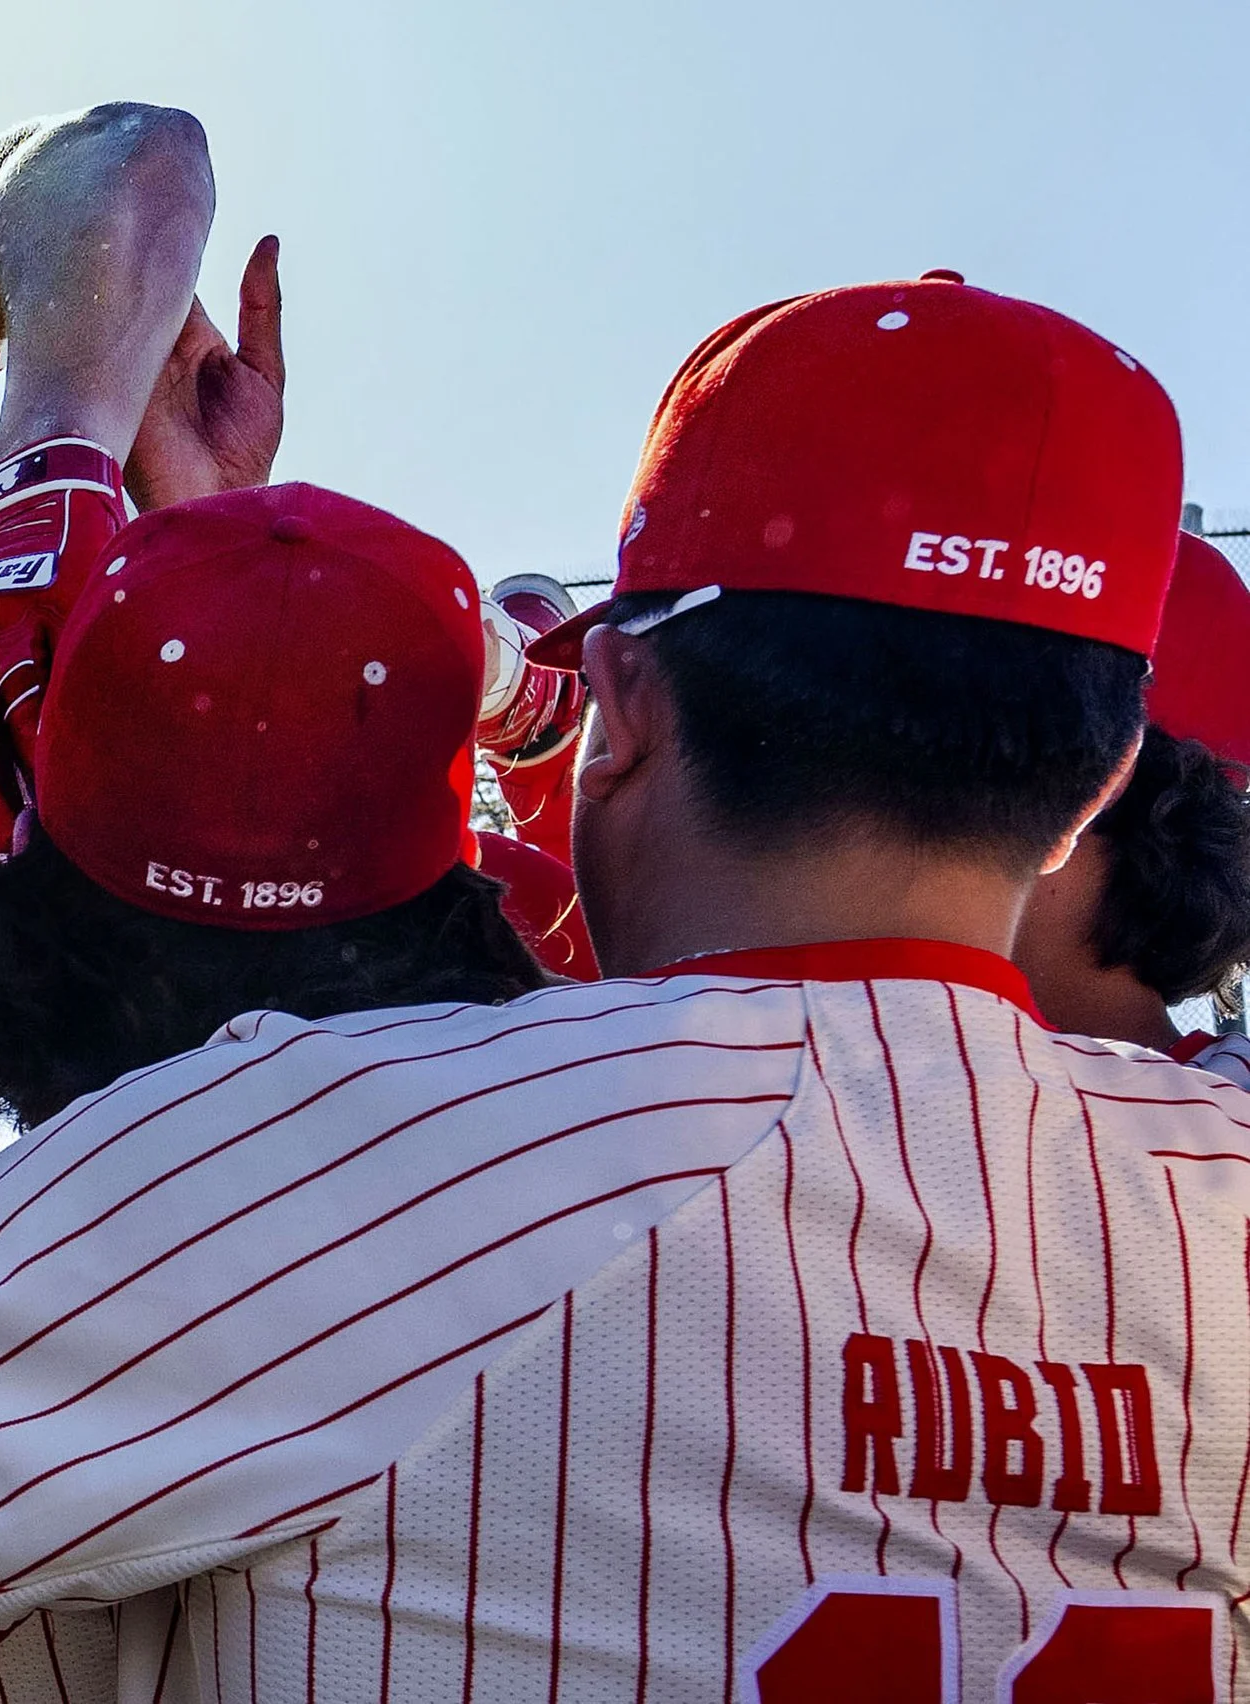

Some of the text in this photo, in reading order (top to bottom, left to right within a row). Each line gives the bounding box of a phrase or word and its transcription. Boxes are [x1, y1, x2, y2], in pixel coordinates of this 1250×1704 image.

[903, 531, 1107, 600] EST. 1896
[145, 860, 325, 909] EST. 1896
[840, 1332, 1162, 1517] RUBIO
